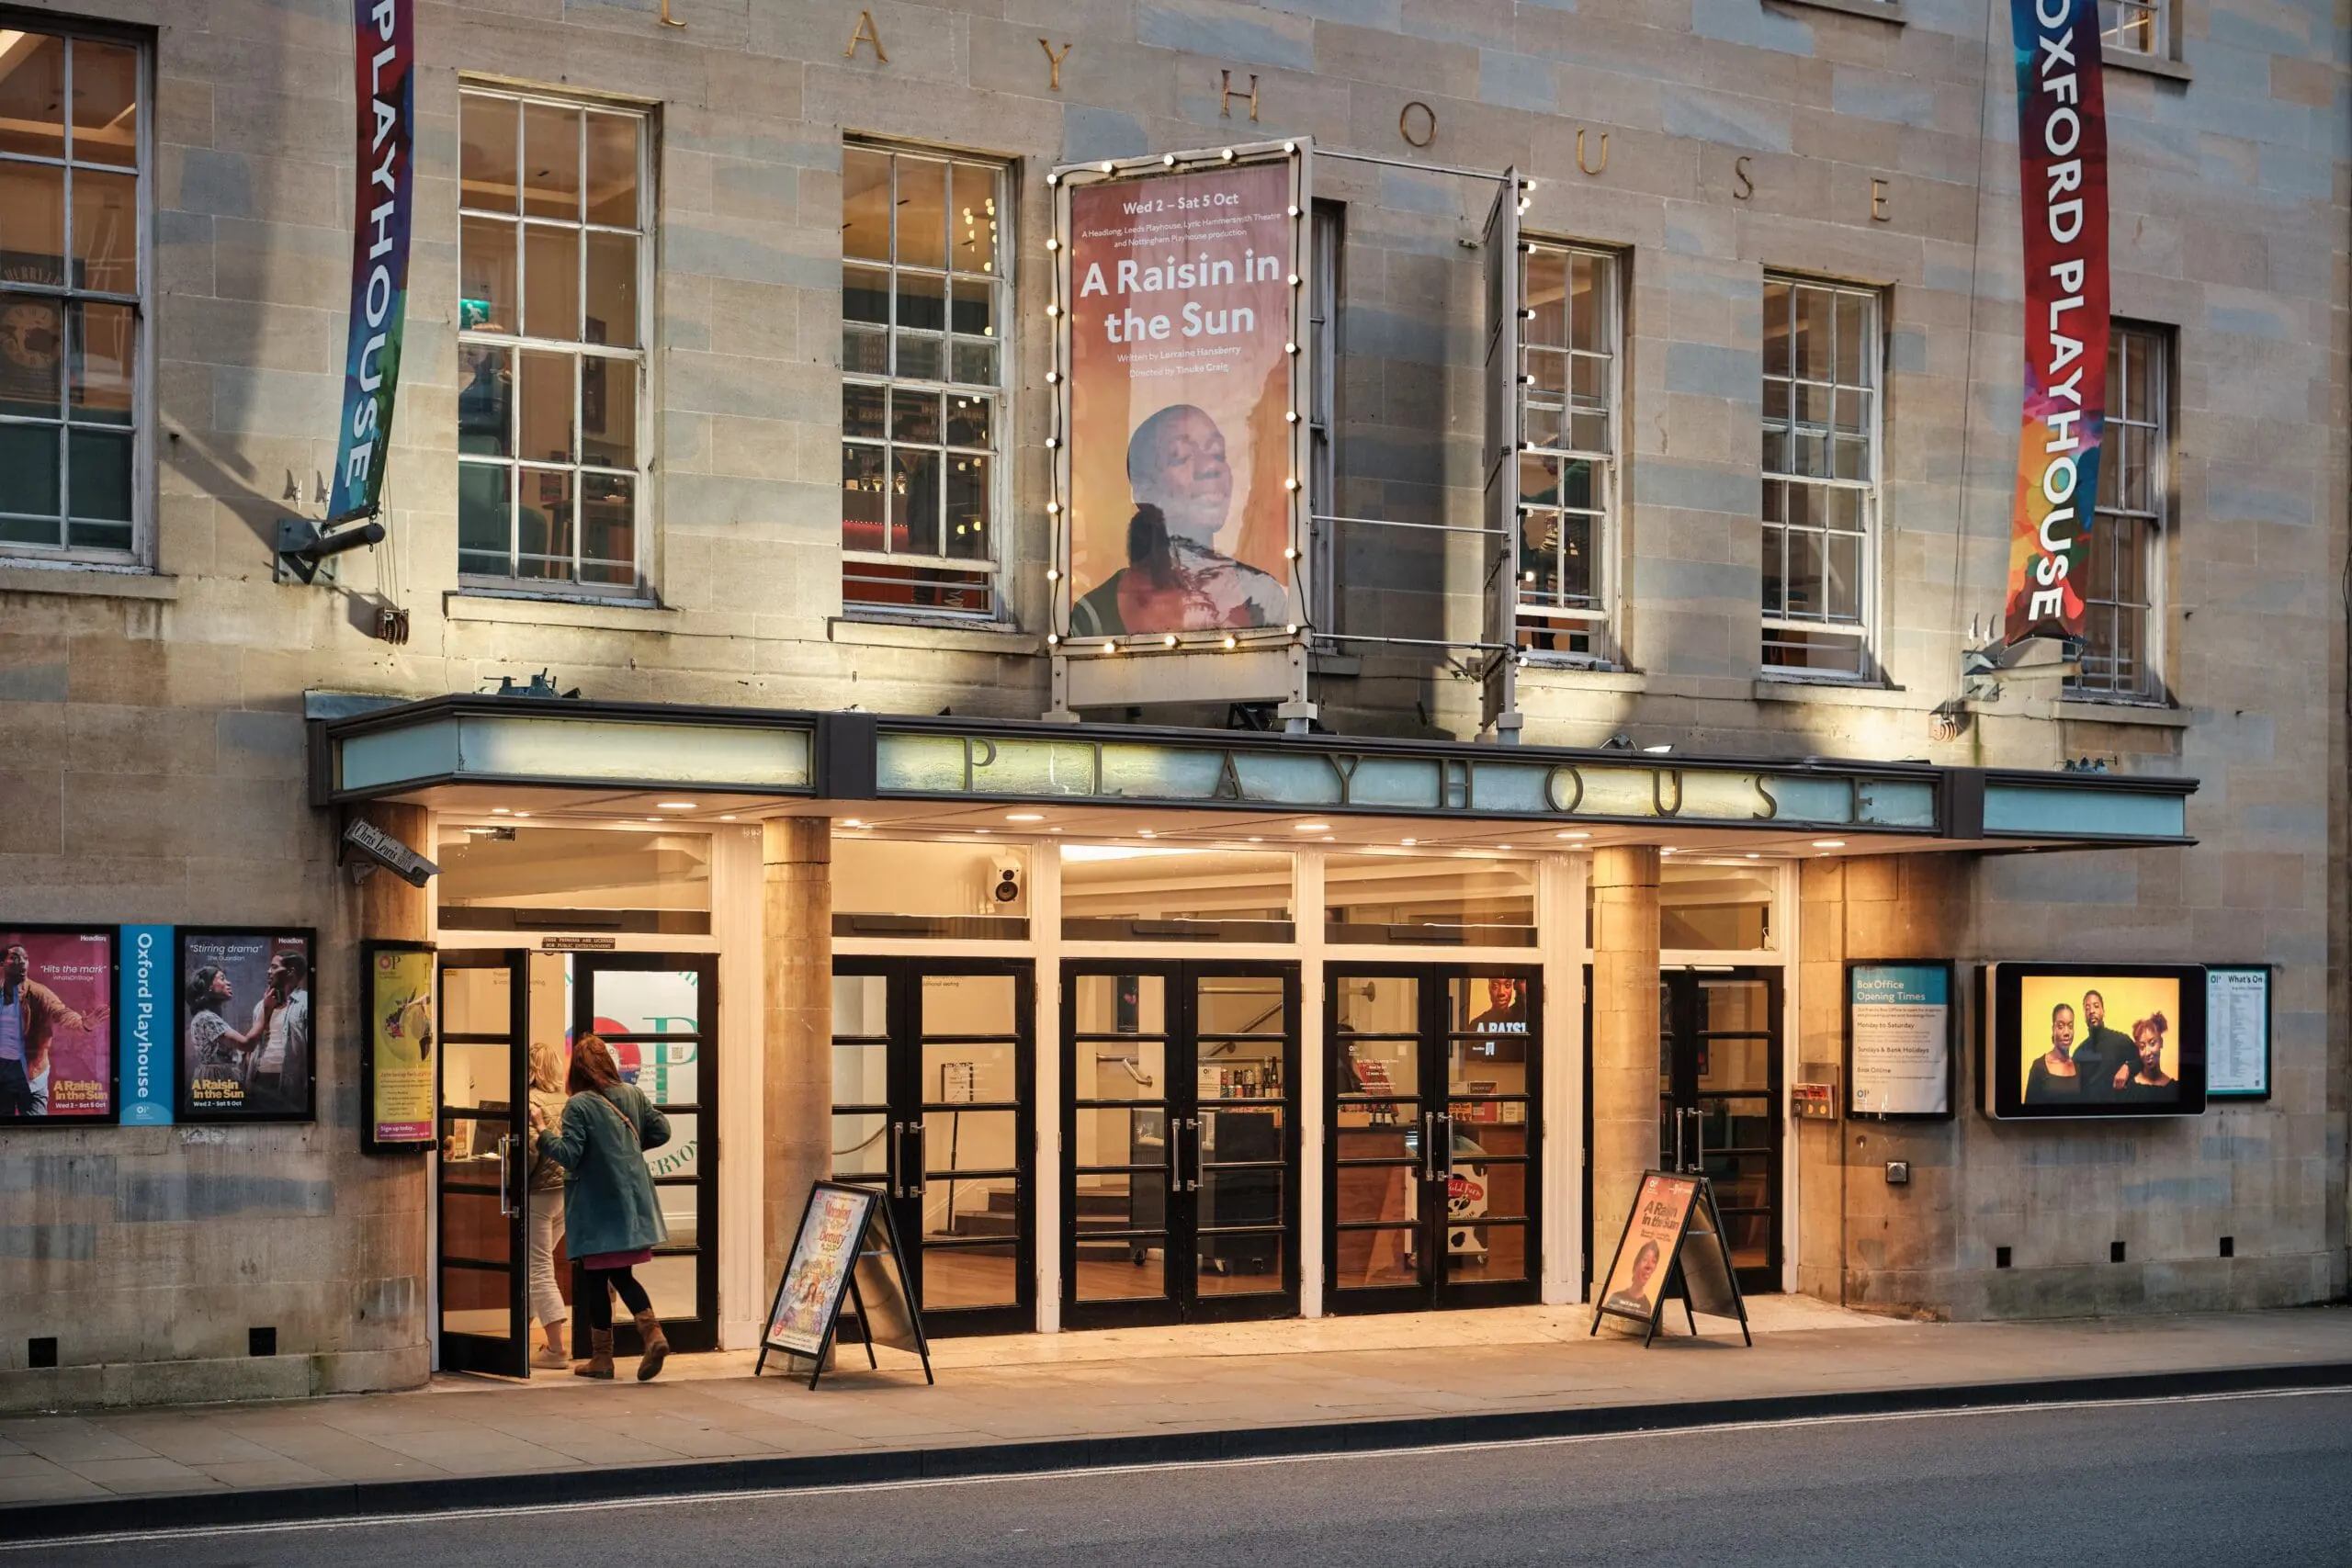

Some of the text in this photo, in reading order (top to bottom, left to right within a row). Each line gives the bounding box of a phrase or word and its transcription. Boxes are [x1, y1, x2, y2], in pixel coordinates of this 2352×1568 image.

[1123, 201, 1152, 215] Wed
[1156, 199, 1163, 212] 2
[1178, 197, 1199, 210] Sat
[1203, 195, 1210, 207] 5
[1214, 193, 1238, 206] Oct
[1125, 225, 1145, 234] Leeds
[1183, 220, 1201, 229] Lyric
[1202, 215, 1252, 226] Hammersmith
[1253, 212, 1281, 221] Theatre
[1128, 236, 1170, 247] Nottingham
[1171, 233, 1207, 244] Playhouse
[1208, 229, 1247, 240] production
[1080, 248, 1280, 298] A Raisin in
[1104, 301, 1254, 343] the Sun
[1117, 345, 1241, 364] Written by Lorraine Hansberry
[1130, 362, 1229, 378] Directed by Tinuke Craig
[2028, 258, 2084, 621] PLAYHOUSE
[137, 932, 153, 998] Oxford
[1857, 980, 1904, 989] Box Office
[2228, 975, 2251, 983] What's
[2252, 975, 2263, 983] On
[1857, 992, 1926, 1003] Opening Times
[133, 1002, 153, 1099] Playhouse
[54, 1080, 102, 1091] A Raisin
[192, 1079, 238, 1089] A Raisin
[66, 1090, 85, 1100] the
[86, 1090, 108, 1100] Sun
[204, 1089, 222, 1099] the
[223, 1089, 244, 1099] Sun
